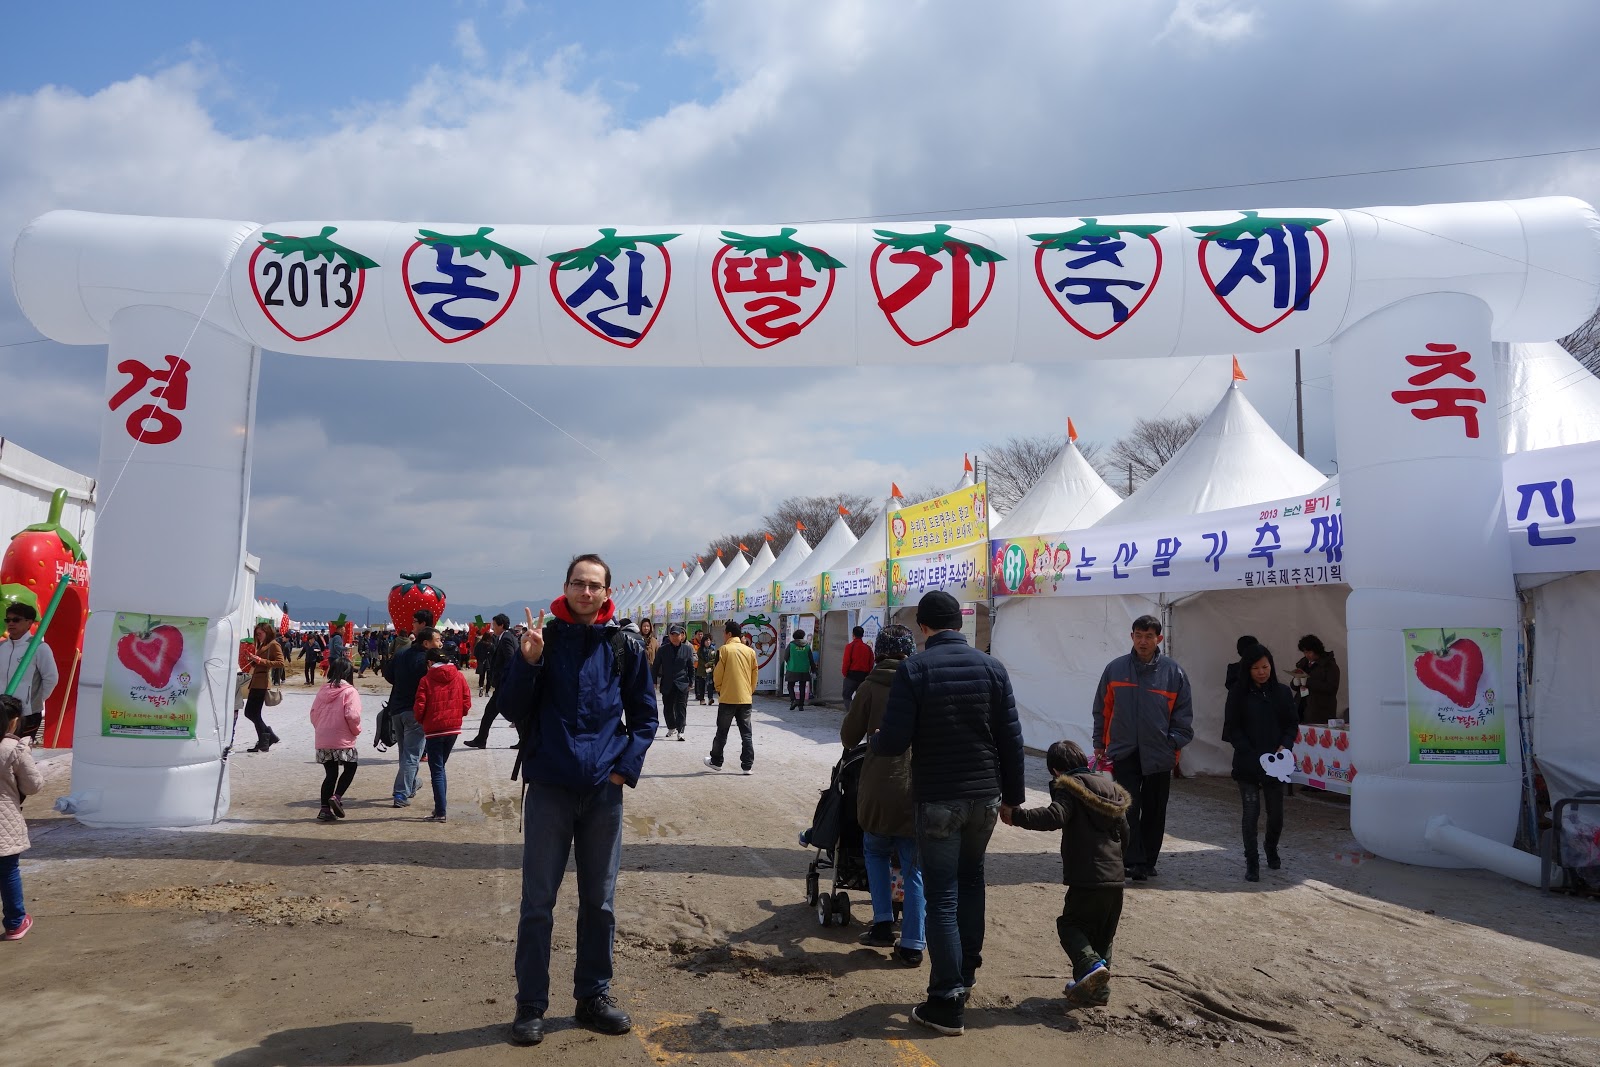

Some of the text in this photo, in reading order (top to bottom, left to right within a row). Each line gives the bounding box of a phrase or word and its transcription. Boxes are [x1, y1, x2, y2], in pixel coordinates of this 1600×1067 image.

[262, 260, 355, 309] 2013
[108, 354, 191, 445] 경
[1391, 342, 1487, 438] 축
[910, 517, 927, 535] 우리집
[1259, 508, 1279, 521] 2013
[1283, 504, 1302, 518] 논산
[1304, 495, 1330, 514] 딸기
[1516, 478, 1576, 546] 진
[907, 566, 927, 593] 우리집
[927, 562, 947, 592] 도로명
[1005, 548, 1022, 587] 81
